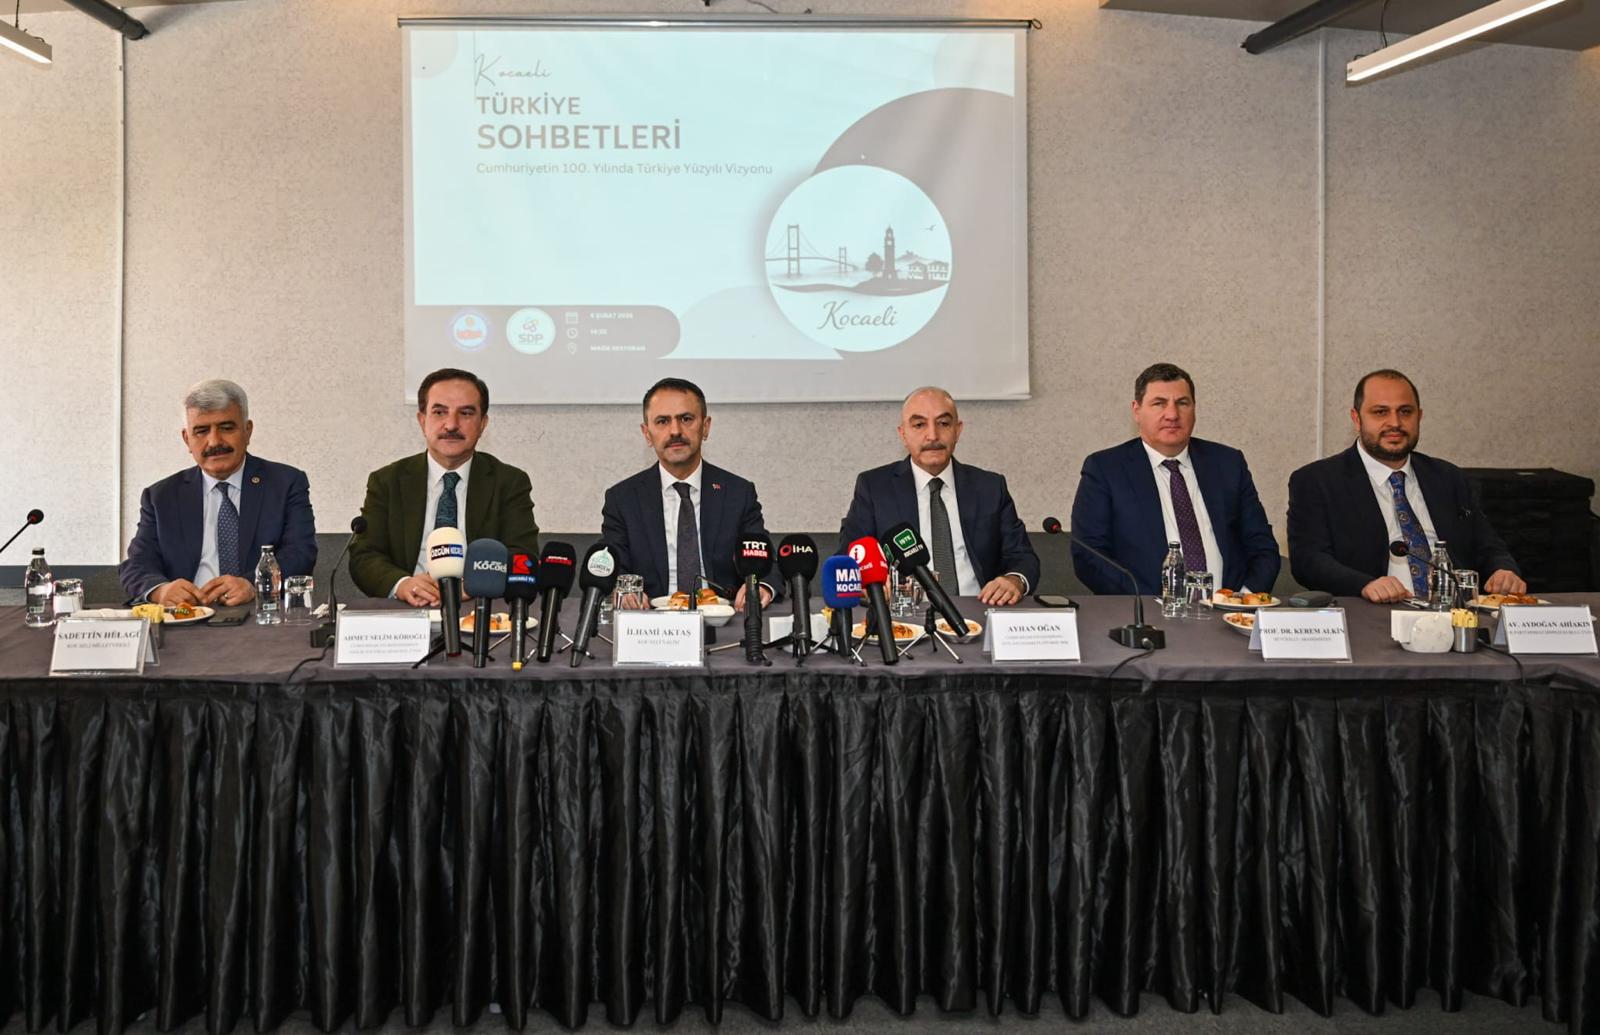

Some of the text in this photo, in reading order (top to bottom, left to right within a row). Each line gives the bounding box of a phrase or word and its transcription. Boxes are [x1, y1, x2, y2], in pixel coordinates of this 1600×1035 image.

[474, 53, 551, 87] Kocaeli
[476, 92, 581, 115] TÜRKİYE
[477, 119, 680, 150] SOHBETLERİ
[476, 162, 773, 176] Cumhuriyetin 100. Yılında Türkiye Yüzyılı Vizyonu
[816, 299, 899, 330] Kocaeli
[517, 333, 545, 346] SDP
[743, 541, 767, 550] TRT
[793, 545, 813, 553] İHA
[743, 550, 768, 558] HABER
[627, 627, 691, 637] İLHAMİ AKTAŞ
[1037, 623, 1061, 632] OĞAN
[57, 631, 101, 640] SADETTİN
